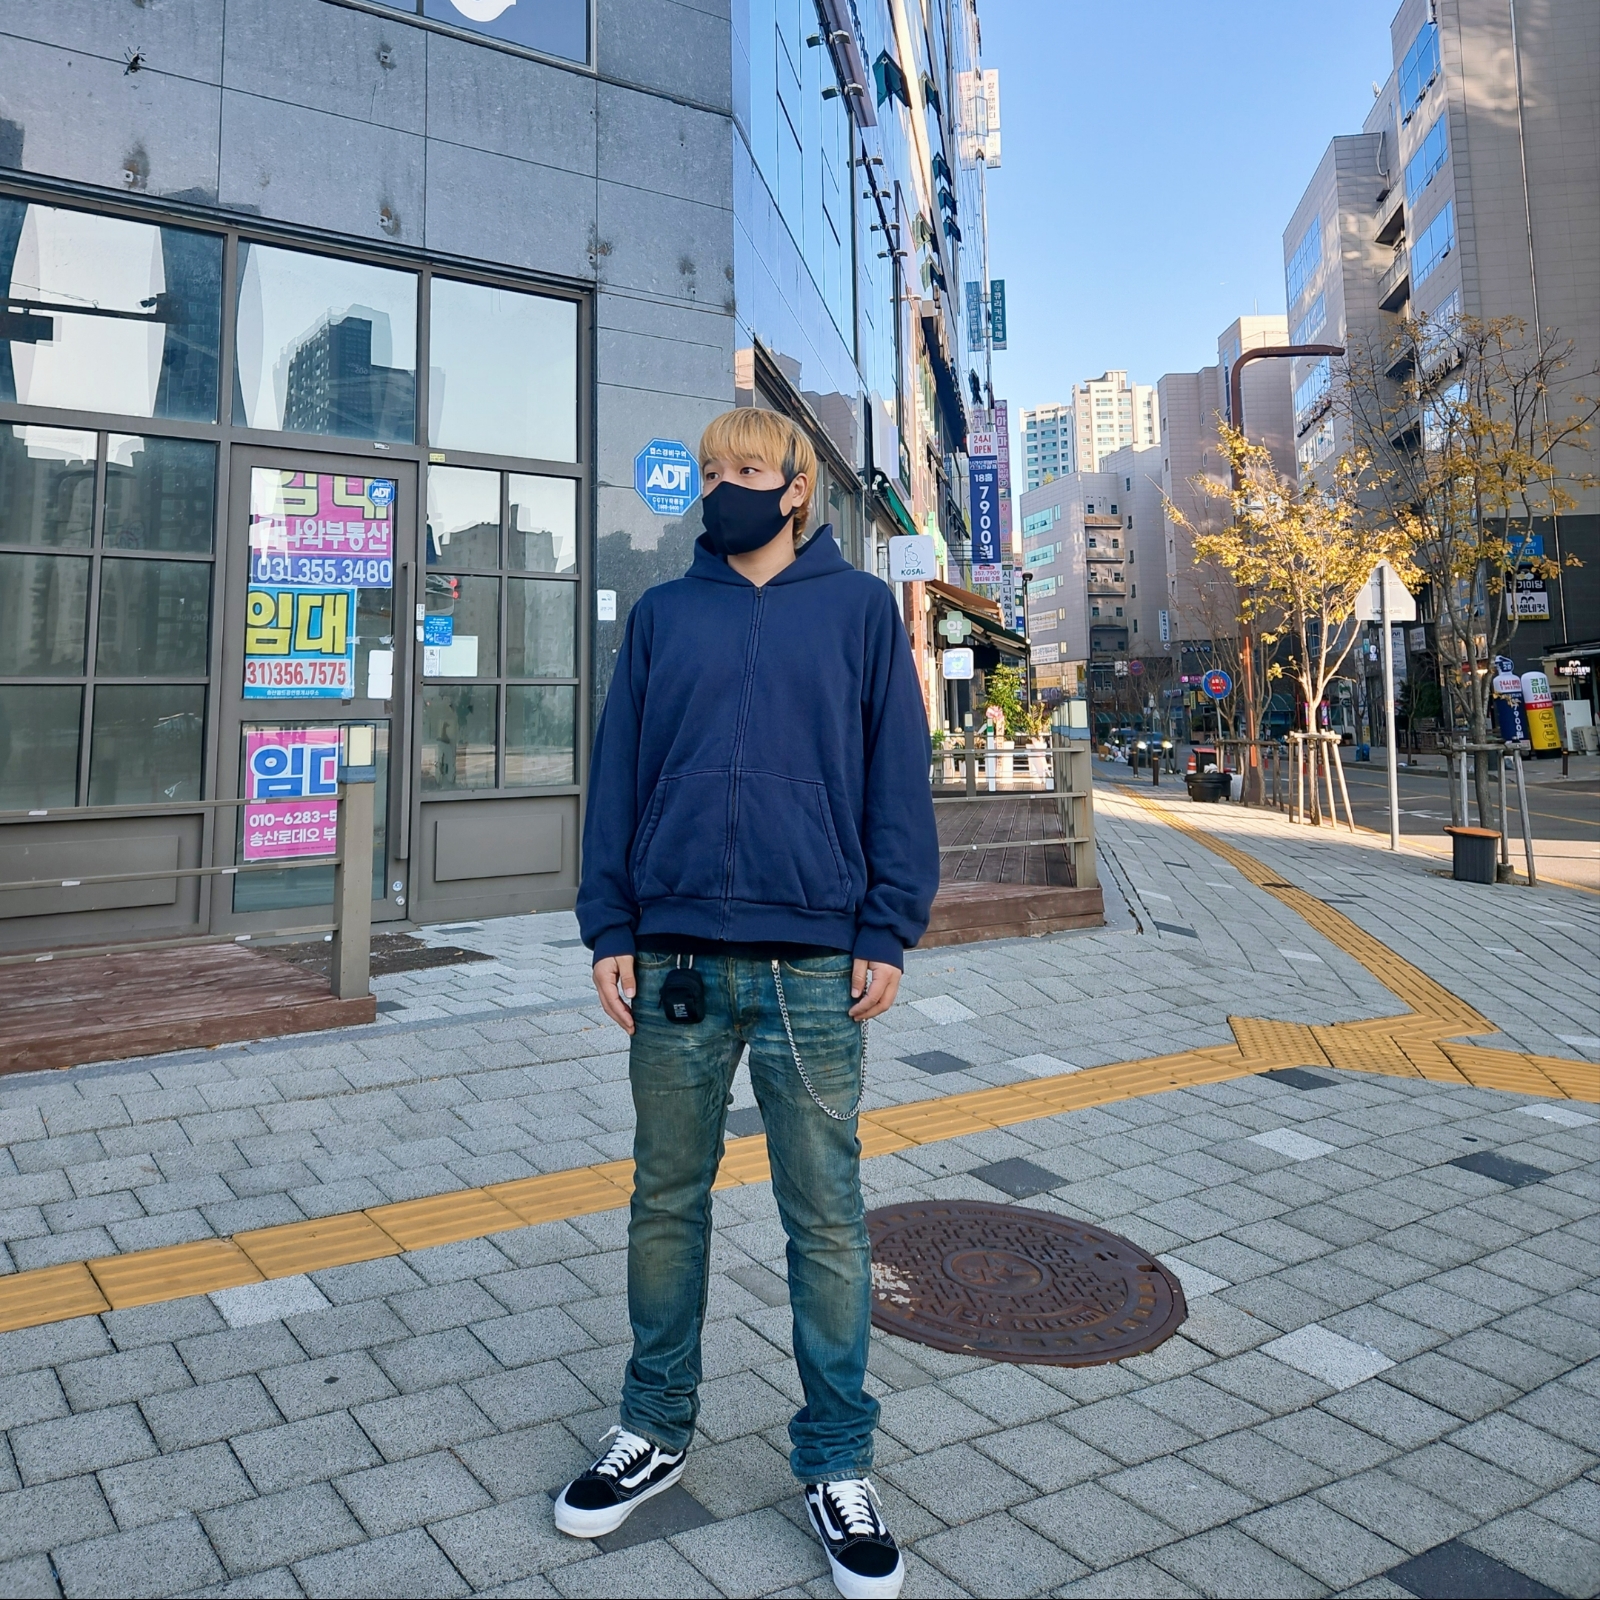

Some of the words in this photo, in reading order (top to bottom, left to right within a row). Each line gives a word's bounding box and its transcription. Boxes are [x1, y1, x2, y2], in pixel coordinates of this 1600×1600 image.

[974, 434, 991, 444] 24시
[974, 445, 992, 455] OPEN
[647, 463, 690, 491] ADT
[372, 487, 391, 499] ADT
[900, 568, 927, 576] KOSAL
[244, 591, 348, 655] 임대
[946, 620, 963, 637] 약
[244, 661, 347, 686] 31)356.7575
[249, 828, 320, 847] 송산로데오
[1011, 1310, 1102, 1329] telecom
